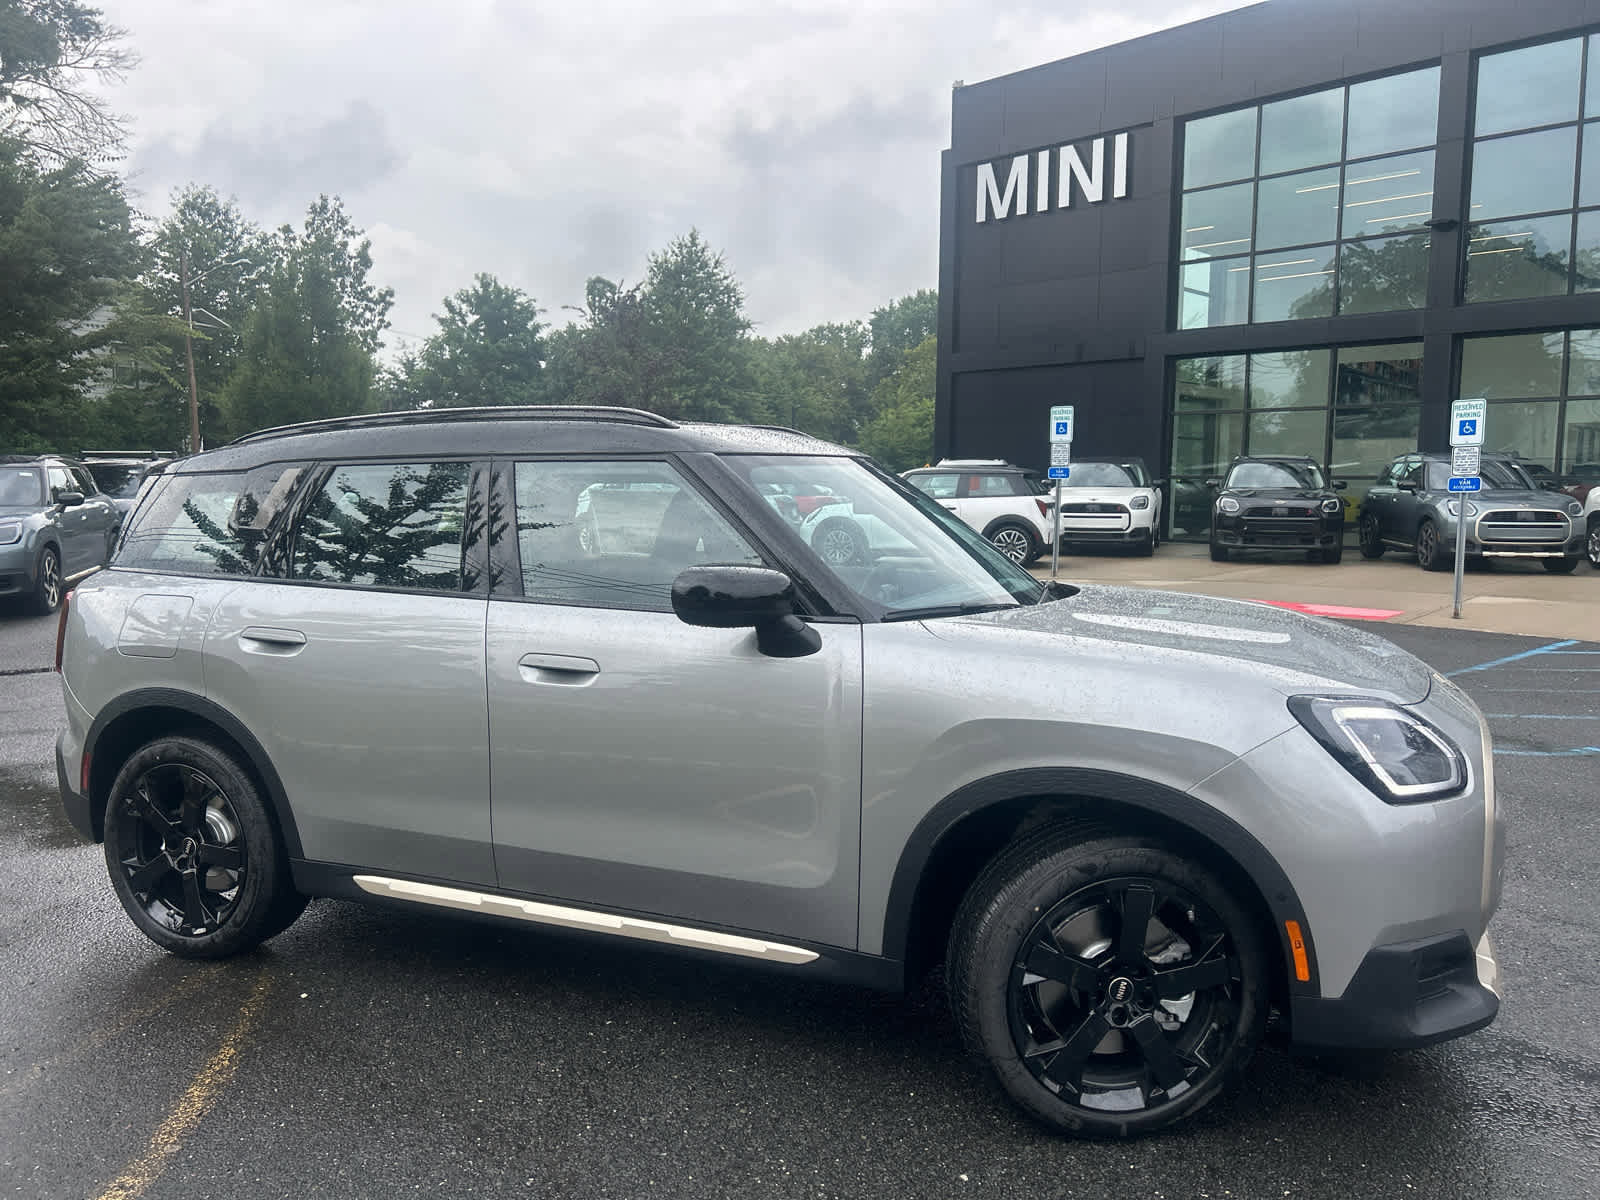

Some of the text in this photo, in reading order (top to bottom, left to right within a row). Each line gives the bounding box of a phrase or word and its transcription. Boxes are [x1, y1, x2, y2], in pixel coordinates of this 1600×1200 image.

[976, 132, 1128, 223] MINI
[1455, 403, 1483, 411] RESERVED
[1115, 981, 1128, 1000] MINI
